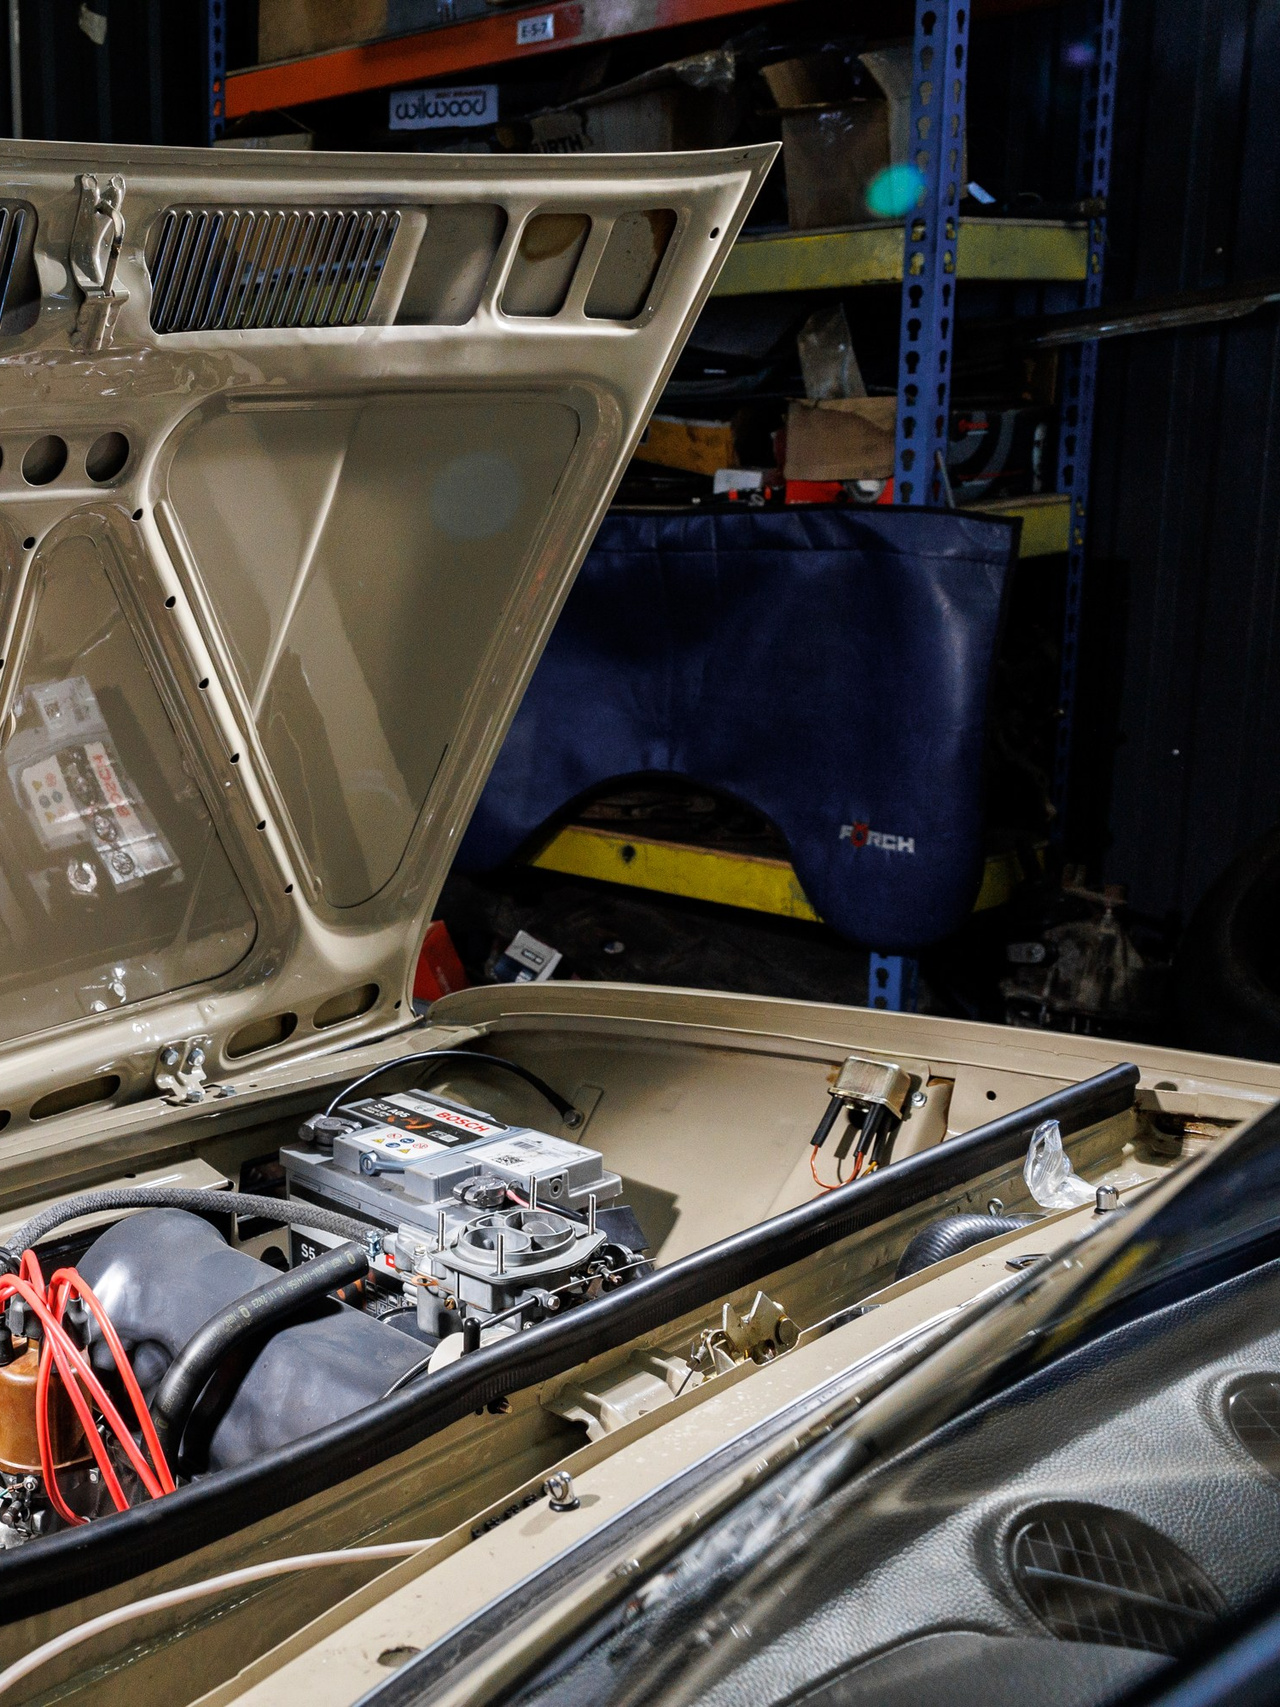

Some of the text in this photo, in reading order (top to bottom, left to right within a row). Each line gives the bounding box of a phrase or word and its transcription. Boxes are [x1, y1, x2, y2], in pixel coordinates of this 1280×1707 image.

[521, 21, 548, 38] E-5-7
[395, 90, 487, 120] wilwood
[435, 1111, 490, 1133] BOSCH
[300, 1243, 316, 1261] S5
